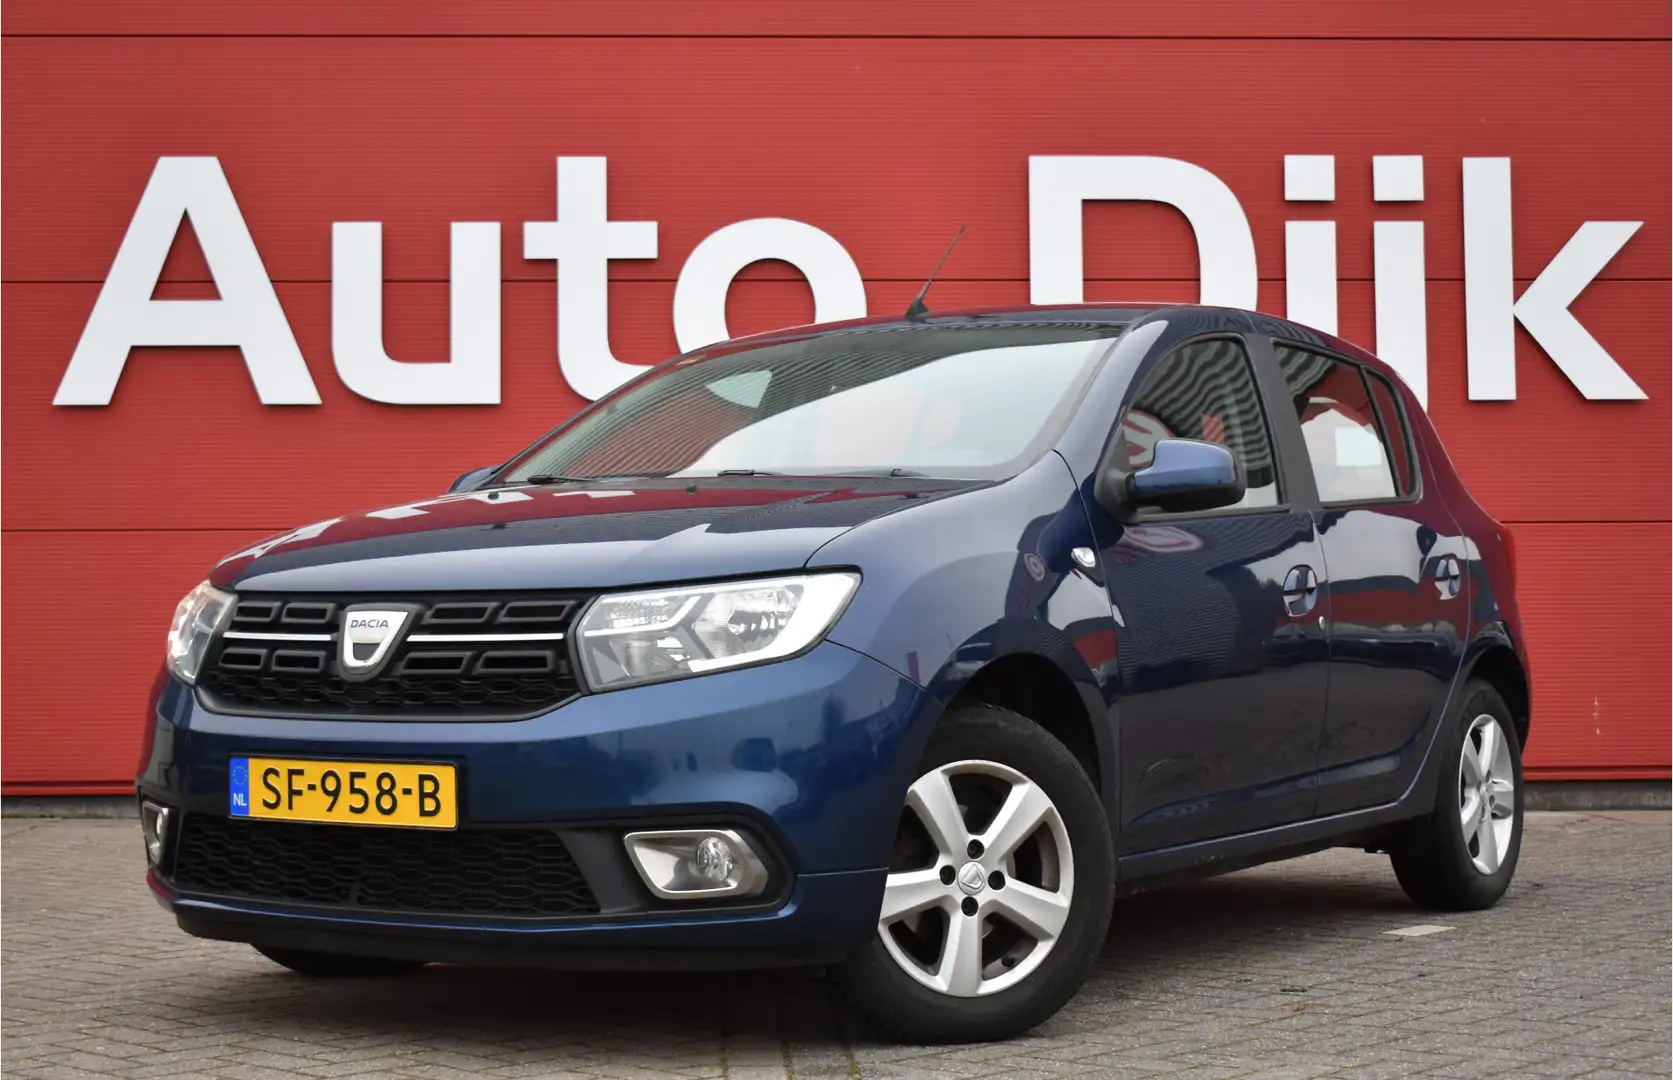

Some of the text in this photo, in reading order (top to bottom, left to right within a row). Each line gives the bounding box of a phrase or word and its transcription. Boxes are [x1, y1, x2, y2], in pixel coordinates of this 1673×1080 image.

[52, 155, 1650, 413] Auto Dijk
[350, 619, 389, 628] DACIA
[233, 793, 247, 806] NL
[262, 767, 441, 817] SF-958-B
